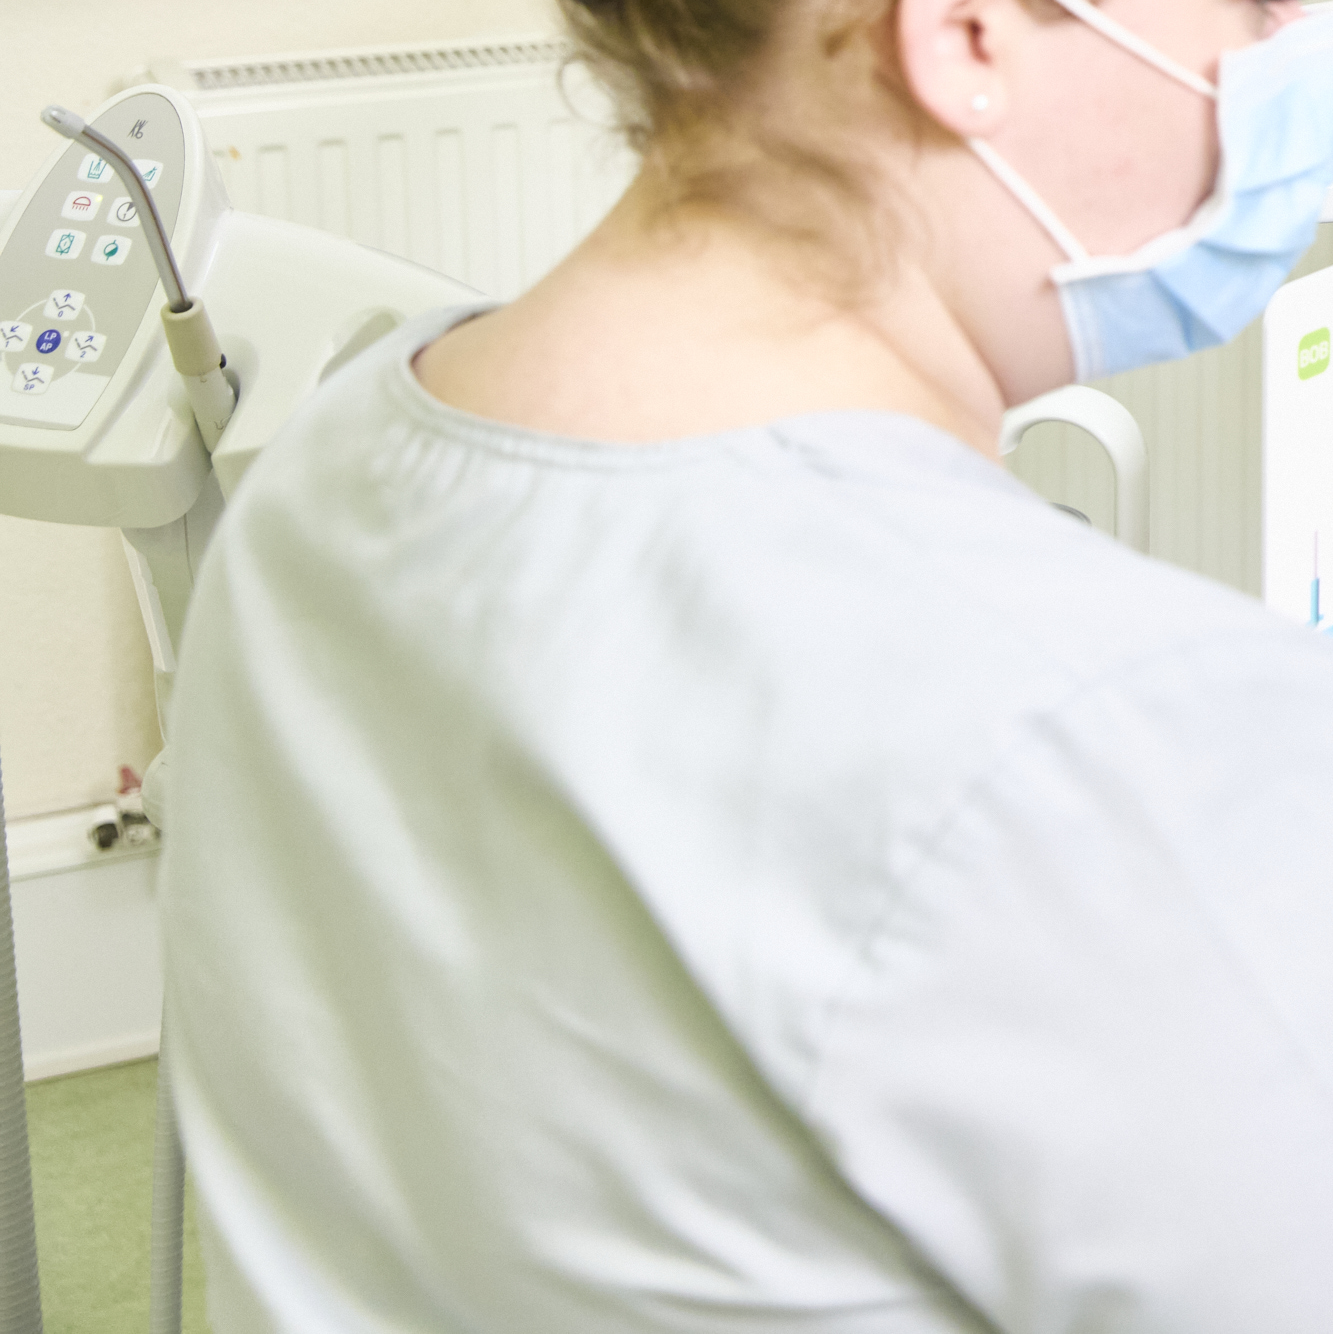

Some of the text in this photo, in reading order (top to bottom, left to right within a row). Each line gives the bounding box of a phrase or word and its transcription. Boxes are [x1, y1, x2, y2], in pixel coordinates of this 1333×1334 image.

[44, 332, 57, 341] LP
[40, 342, 53, 351] AP
[1300, 340, 1329, 369] BOB
